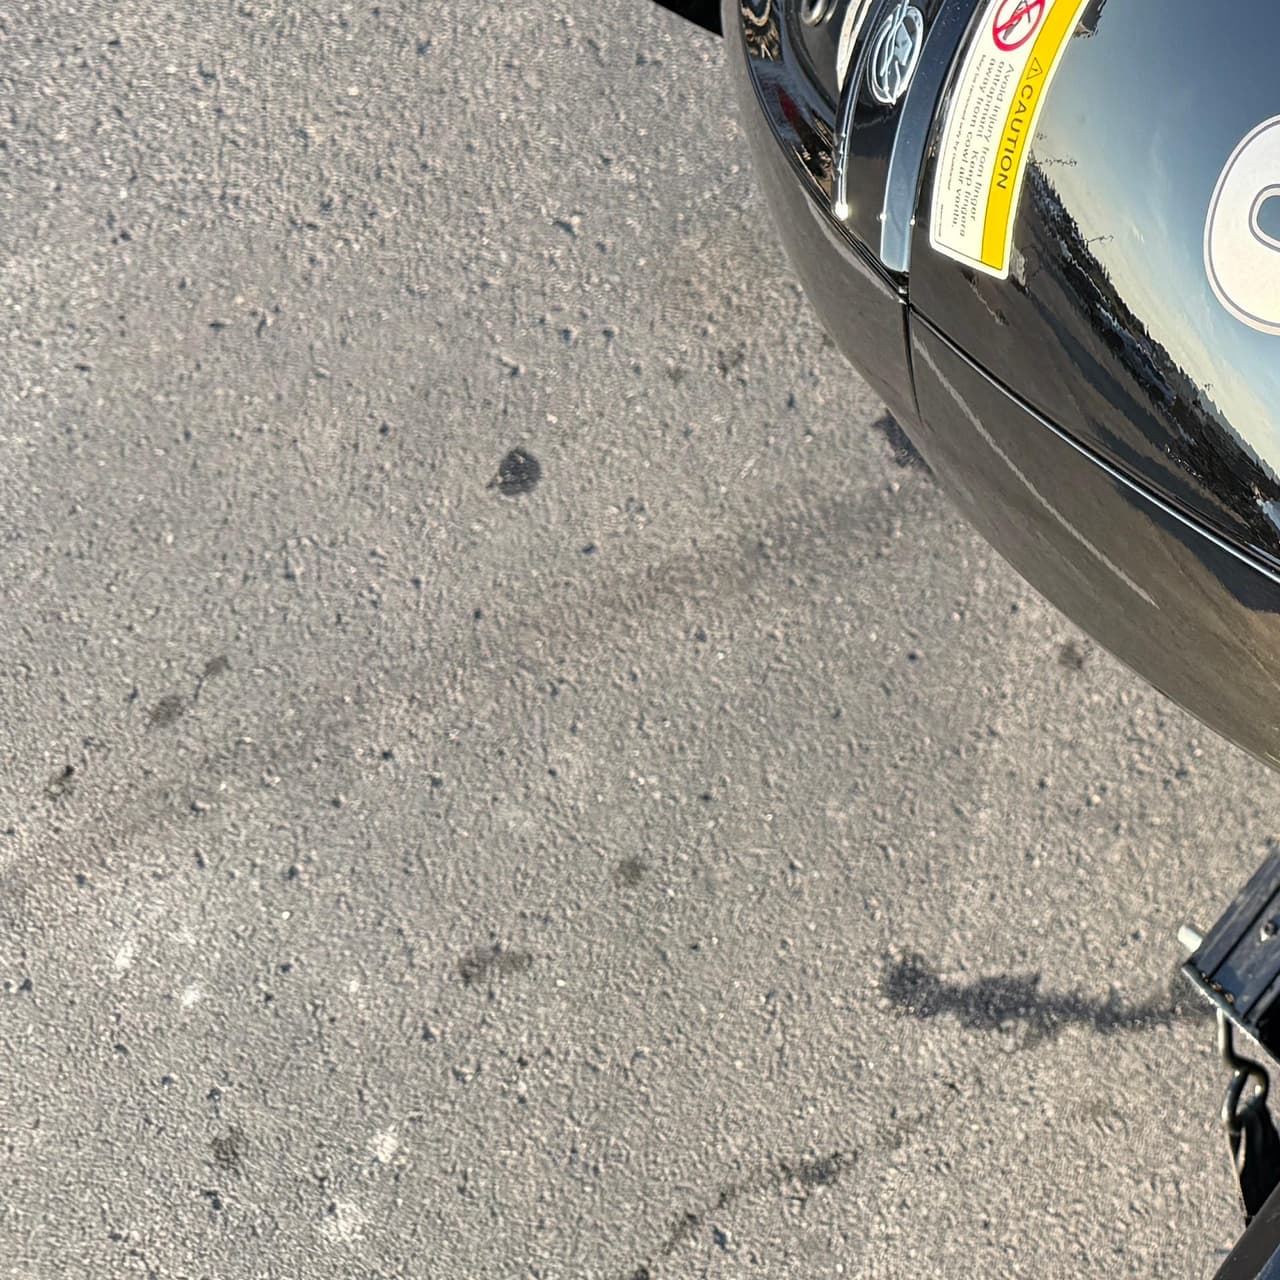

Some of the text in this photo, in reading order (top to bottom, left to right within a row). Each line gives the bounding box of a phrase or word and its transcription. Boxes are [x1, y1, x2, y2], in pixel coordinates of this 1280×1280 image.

[995, 62, 1014, 102] Avoid
[968, 96, 984, 127] from
[984, 104, 1000, 142] injury
[960, 130, 973, 163] cowl
[995, 85, 1034, 189] CAUTION
[976, 146, 989, 177] from
